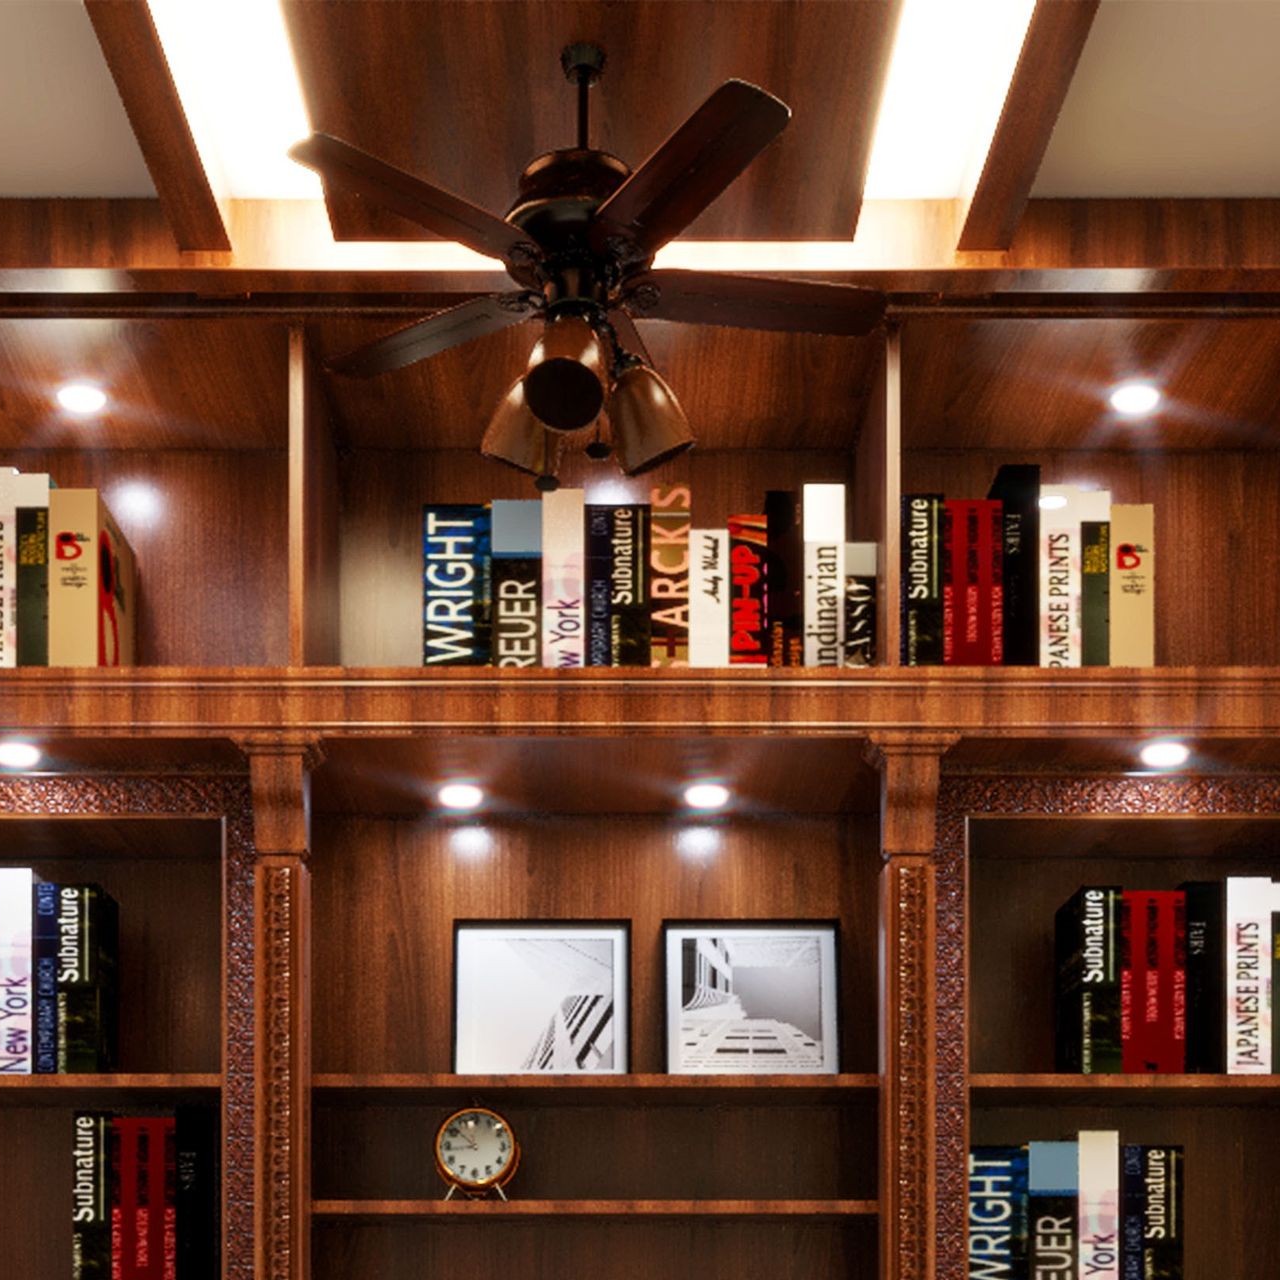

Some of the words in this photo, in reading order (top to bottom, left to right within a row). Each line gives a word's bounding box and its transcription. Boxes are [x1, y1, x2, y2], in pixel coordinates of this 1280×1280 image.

[426, 513, 474, 663] WRIGHT
[611, 509, 632, 605] Subnature
[907, 499, 929, 599] Subnature
[1048, 534, 1069, 596] PRINTS
[547, 599, 581, 644] York
[731, 545, 760, 651] PIN-UP
[39, 957, 54, 996] CHURCH
[57, 888, 79, 982] Subnature
[1081, 890, 1104, 982] Subnature
[1235, 922, 1259, 981] PRINTS
[0, 1028, 28, 1072] New
[1235, 987, 1264, 1066] JAPANESE
[72, 1116, 95, 1222] Subnature
[1144, 1149, 1166, 1239] Subnature
[1083, 1234, 1114, 1275] York
